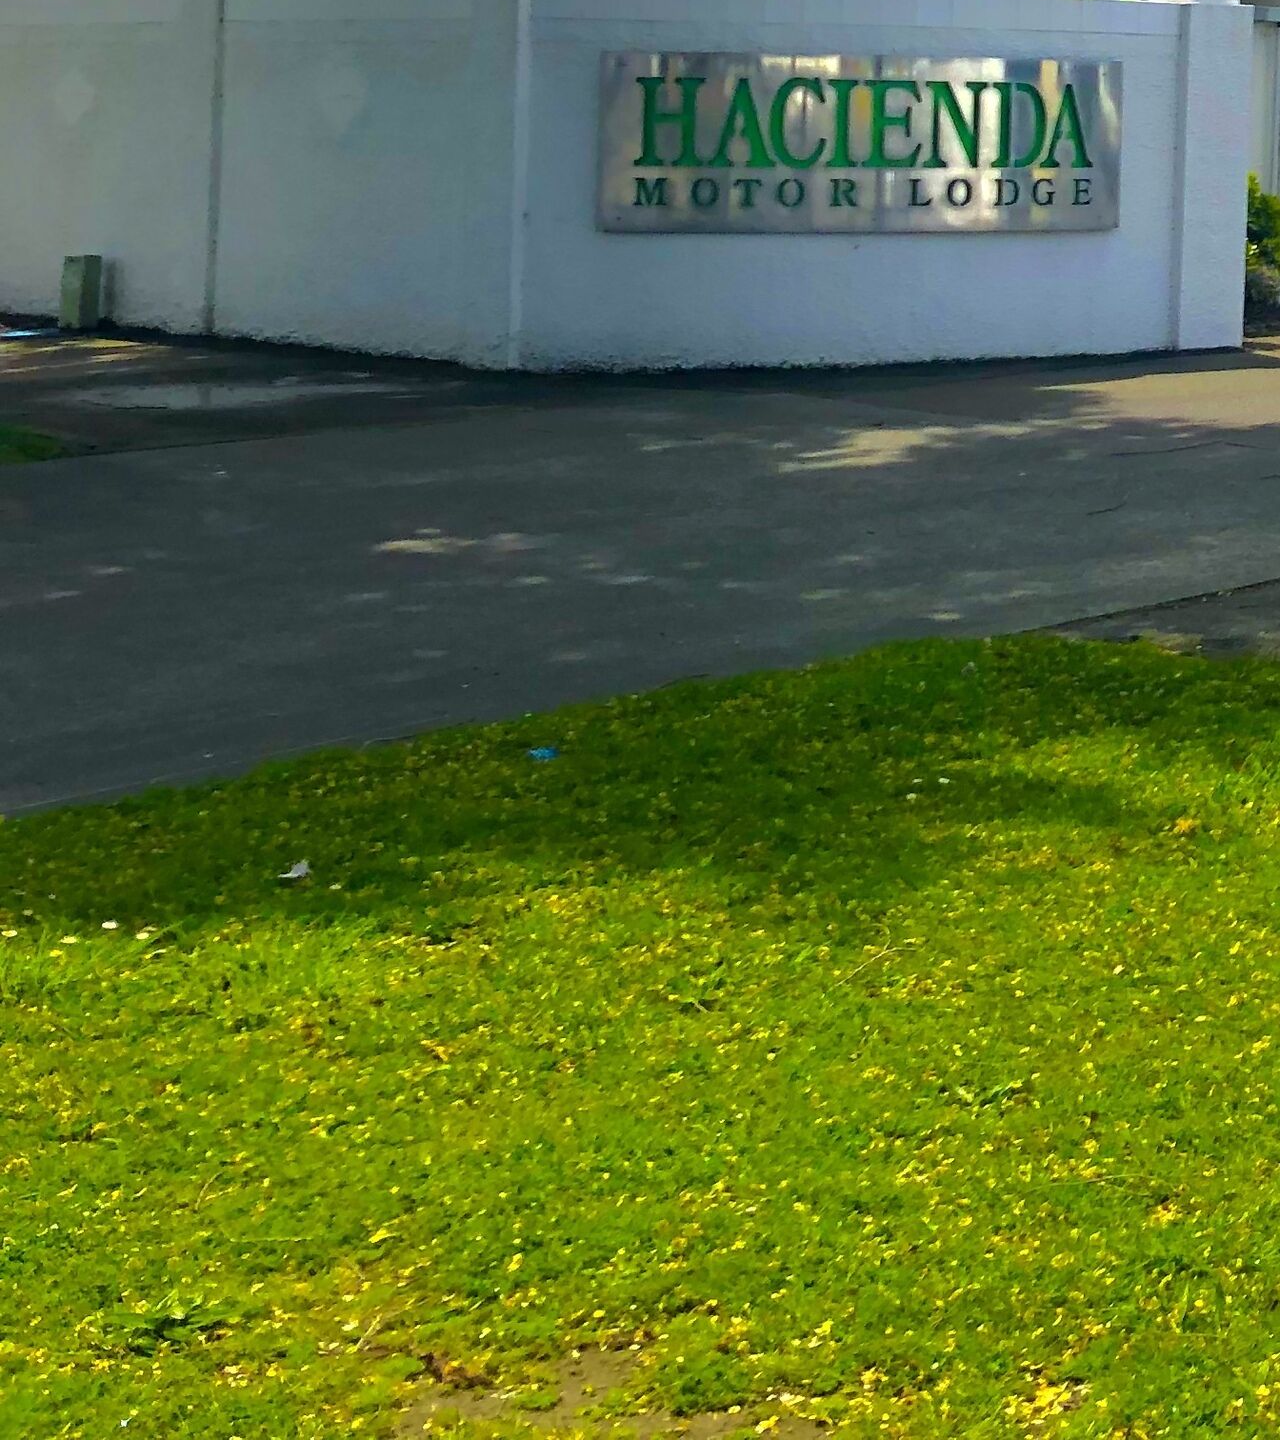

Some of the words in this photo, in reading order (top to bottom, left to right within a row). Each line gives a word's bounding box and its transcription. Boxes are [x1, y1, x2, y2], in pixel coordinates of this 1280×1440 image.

[633, 76, 1093, 169] HACIENDA
[633, 177, 858, 208] MOTOR
[908, 178, 1094, 207] LODGE
